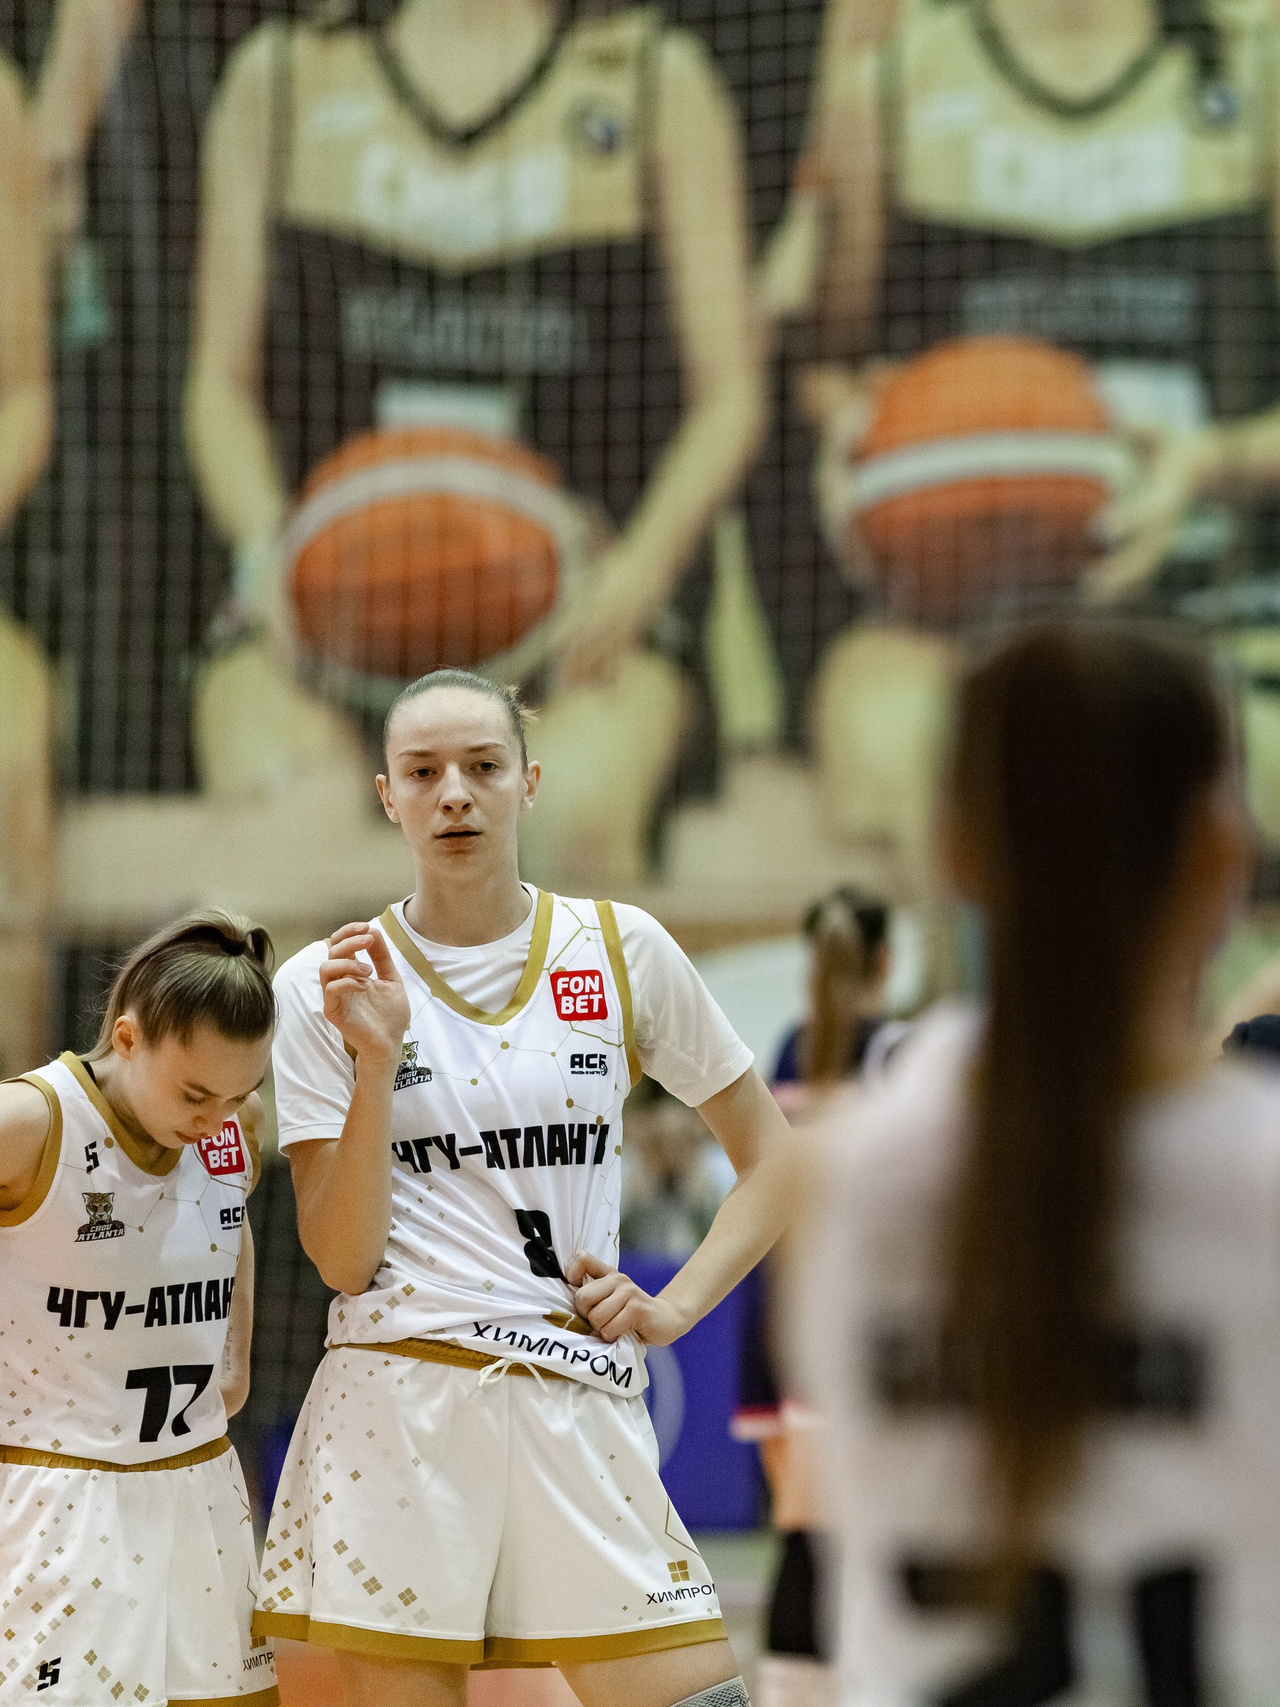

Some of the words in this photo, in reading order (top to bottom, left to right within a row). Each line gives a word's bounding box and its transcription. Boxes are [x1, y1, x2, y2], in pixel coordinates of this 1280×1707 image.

[556, 975, 600, 995] FON
[560, 993, 603, 1015] BET
[394, 1073, 432, 1090] TLANTA
[200, 1126, 236, 1151] FON
[207, 1146, 240, 1169] BET
[77, 1228, 125, 1242] ATLANTA
[90, 1224, 113, 1233] CHGU
[514, 1208, 570, 1285] 8
[470, 1321, 633, 1389] ХИМПРОМ
[645, 1582, 716, 1606] ХИМПРО
[242, 1650, 277, 1672] ХИМПР
